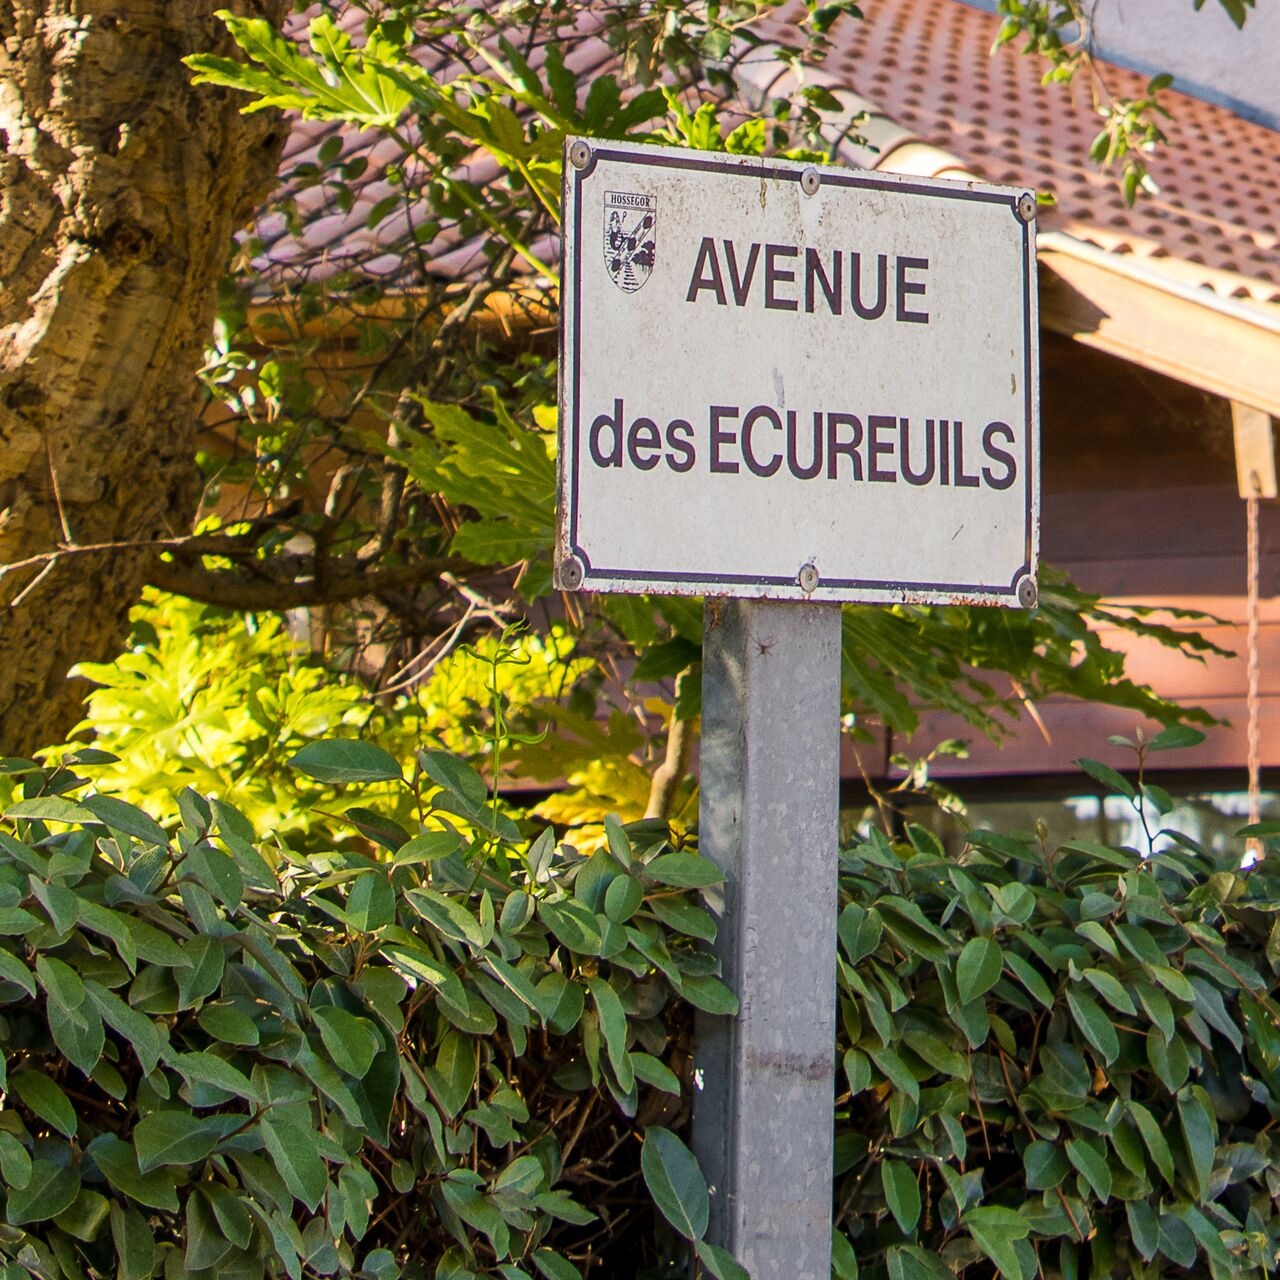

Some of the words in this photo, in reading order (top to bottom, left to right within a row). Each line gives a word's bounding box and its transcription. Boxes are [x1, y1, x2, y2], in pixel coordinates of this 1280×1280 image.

[611, 194, 651, 207] HOSSEGOR
[685, 236, 930, 324] AVENUE
[589, 398, 696, 473] des
[709, 405, 1017, 490] ECUREUILS
